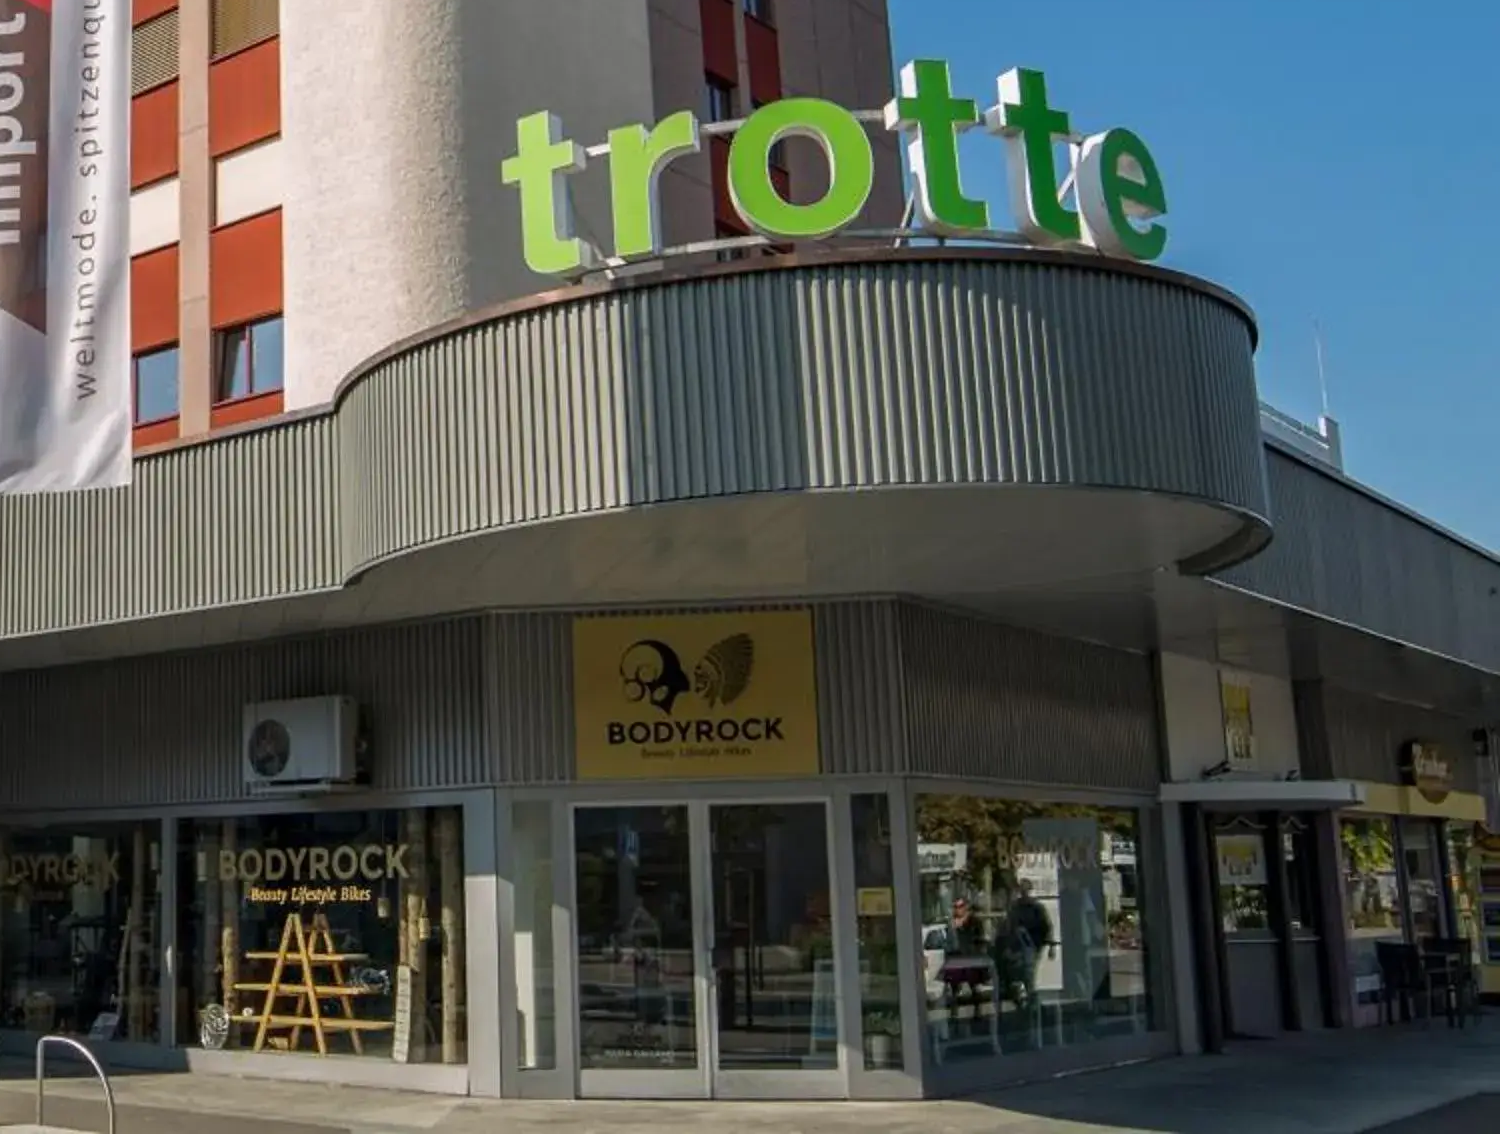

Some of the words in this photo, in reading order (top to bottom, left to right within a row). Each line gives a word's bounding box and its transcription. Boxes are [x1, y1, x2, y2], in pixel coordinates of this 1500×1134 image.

[501, 58, 1167, 274] trotte
[71, 195, 98, 401] weltmode.
[607, 717, 785, 745] BODYROCK
[219, 843, 411, 881] BODYROCK
[250, 886, 288, 905] Beauty
[291, 885, 336, 905] Lifestyle
[340, 884, 372, 901] Bikes
